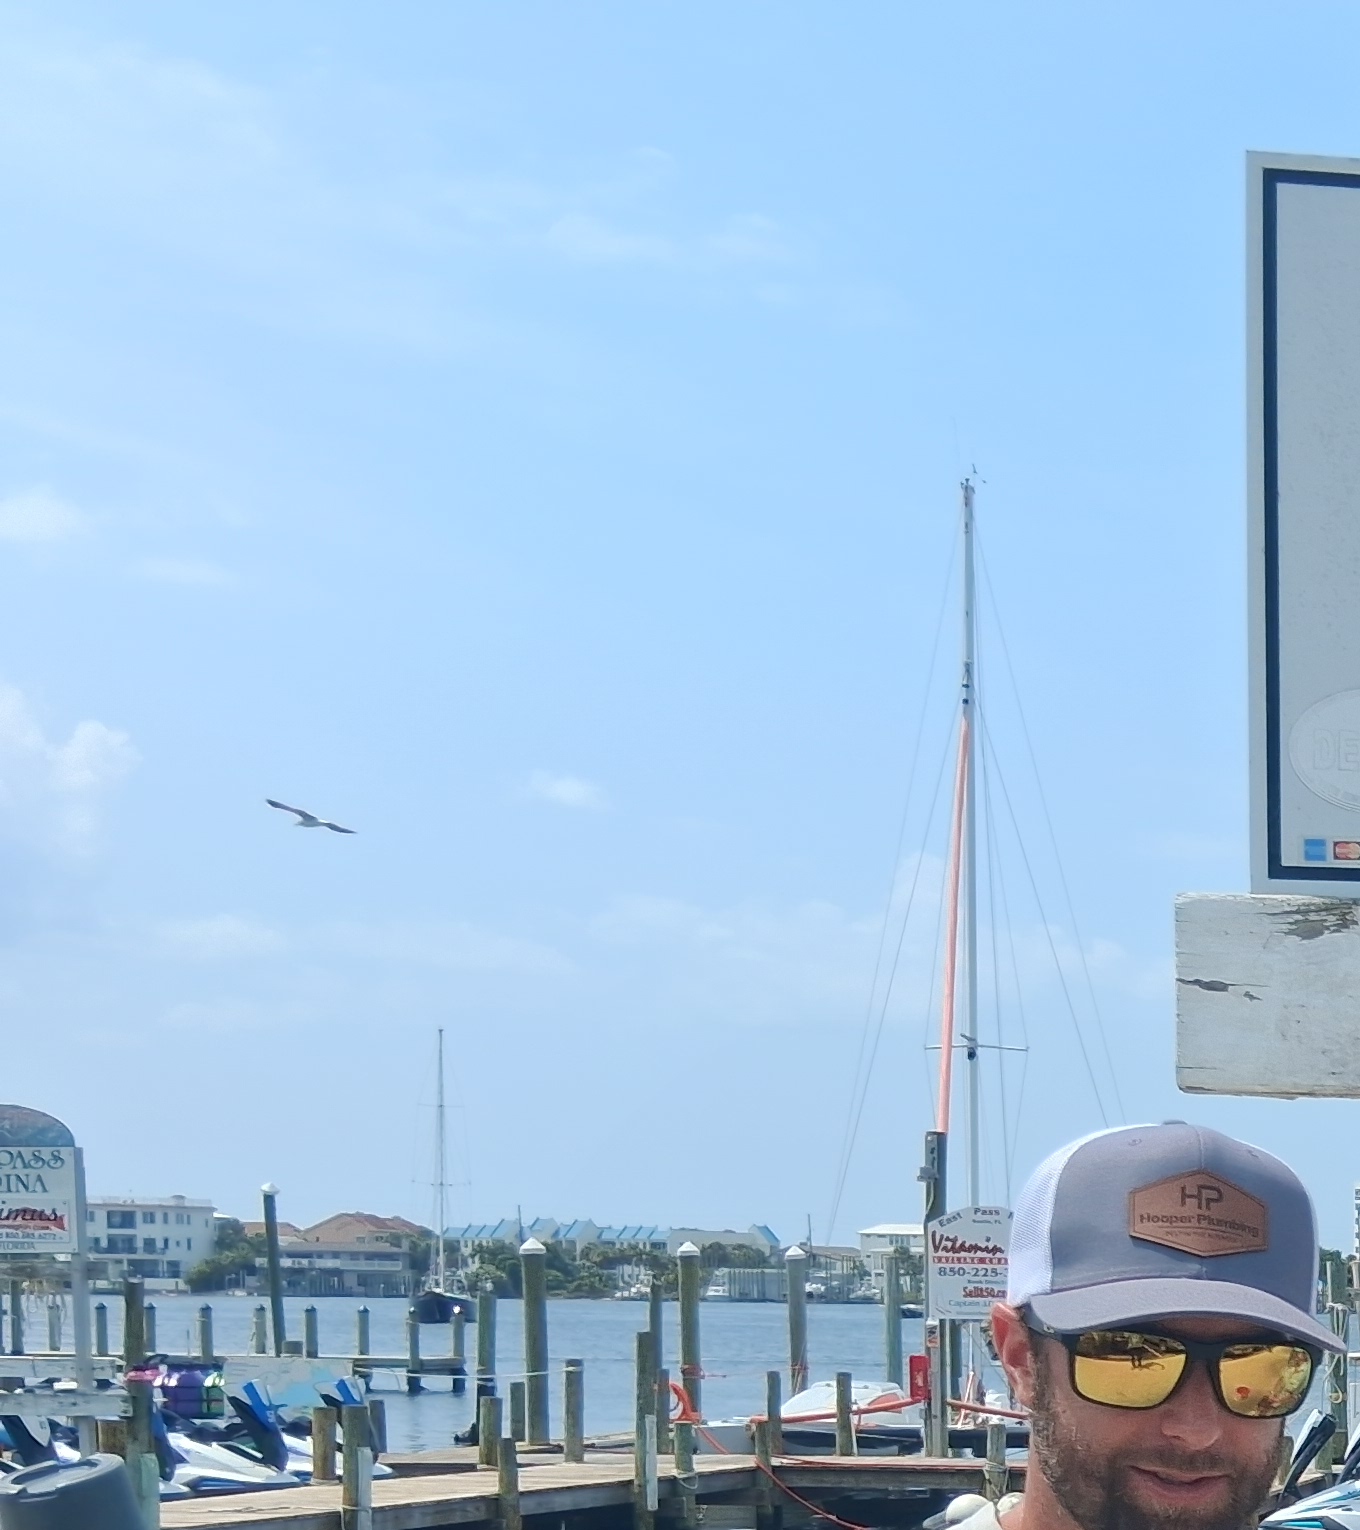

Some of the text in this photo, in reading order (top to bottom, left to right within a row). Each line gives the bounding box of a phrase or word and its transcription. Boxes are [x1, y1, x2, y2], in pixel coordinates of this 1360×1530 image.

[1181, 1184, 1223, 1211] HP
[974, 1208, 1000, 1216] Pass
[1140, 1213, 1194, 1225] Hooper
[1197, 1214, 1259, 1238] Plumbing
